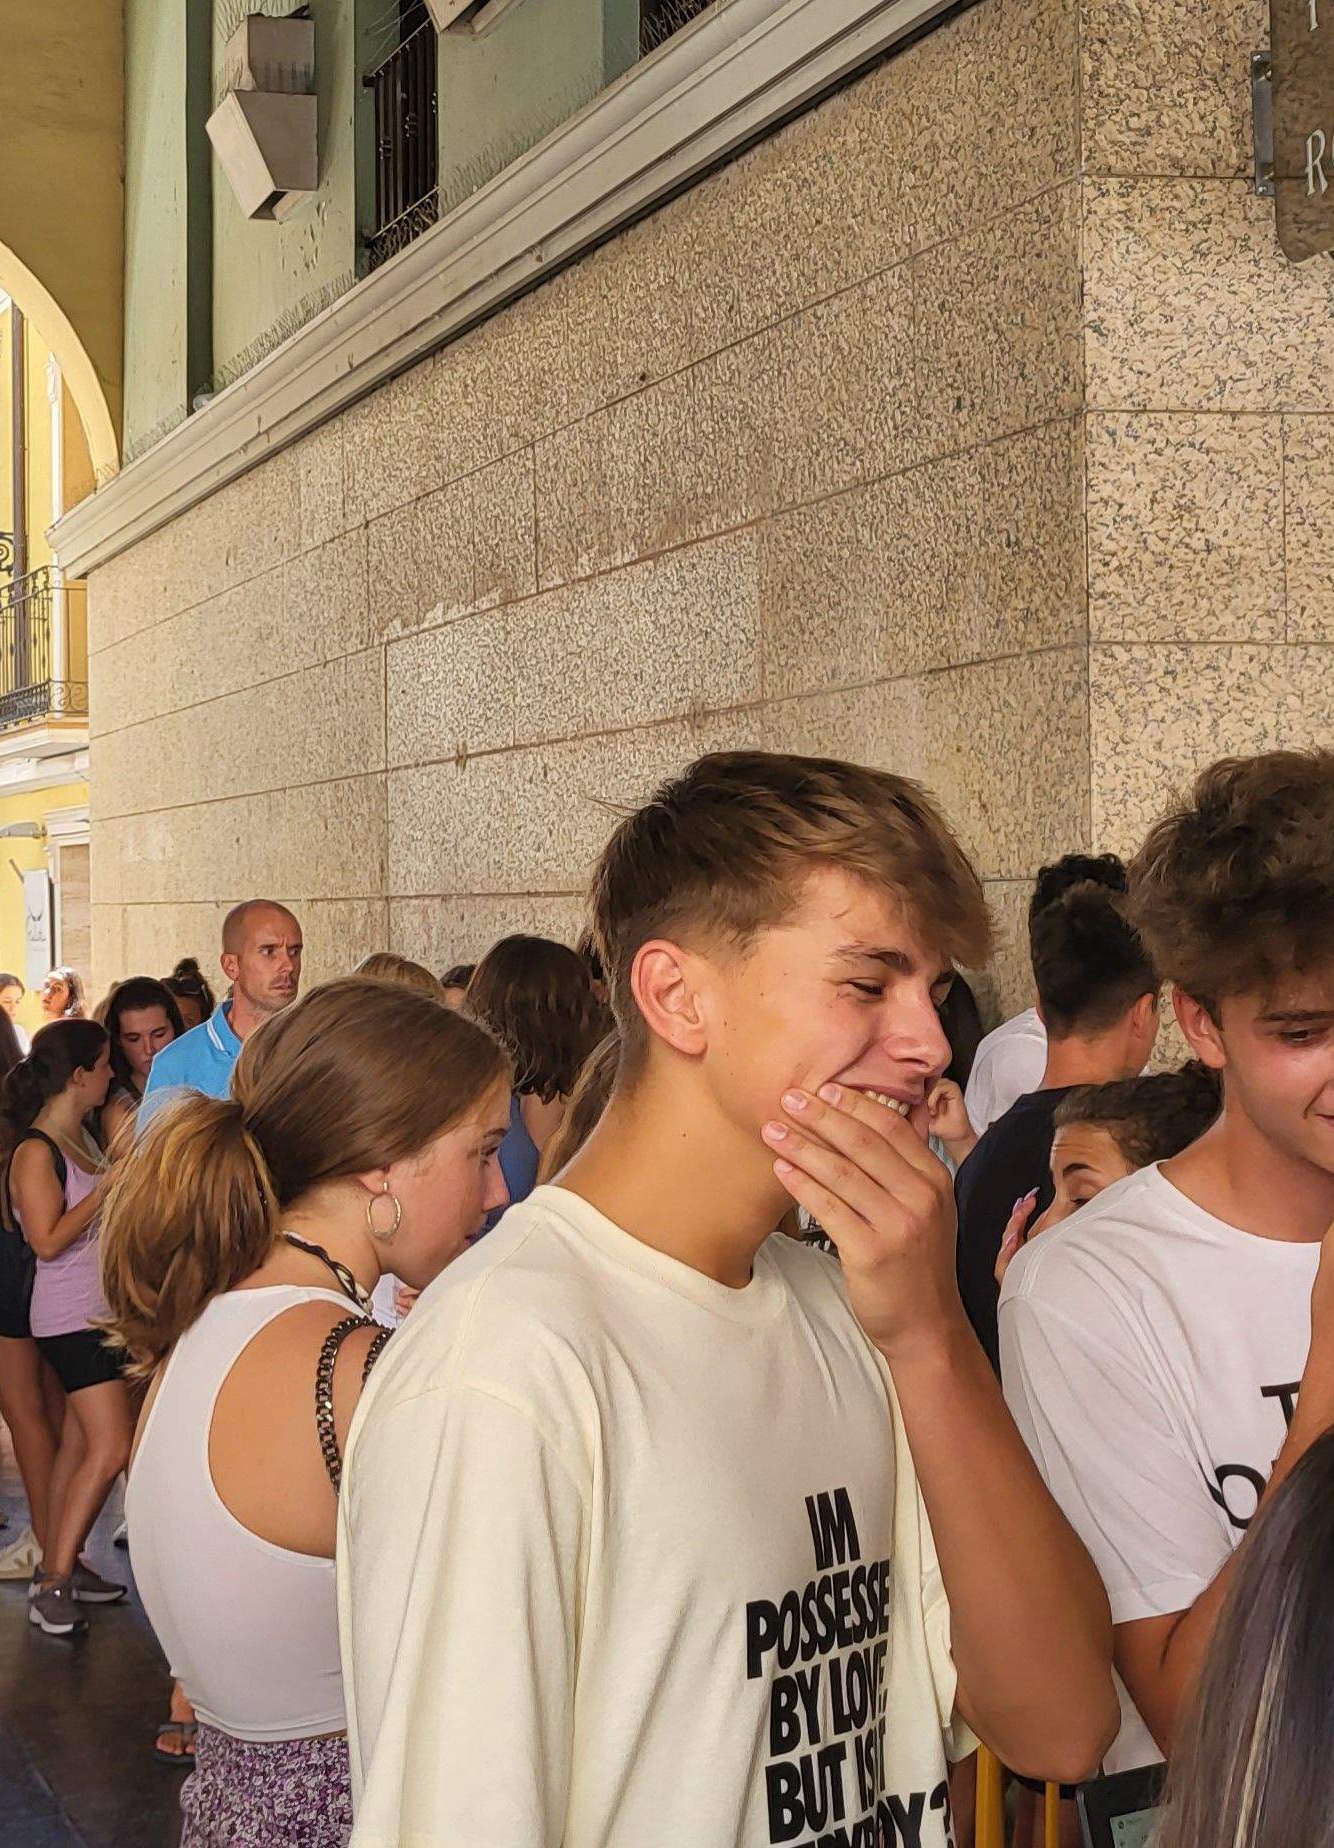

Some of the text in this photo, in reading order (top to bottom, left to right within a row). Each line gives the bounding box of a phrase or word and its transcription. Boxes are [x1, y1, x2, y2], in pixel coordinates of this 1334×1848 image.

[804, 1487, 861, 1572] IM
[770, 1664, 821, 1757] BY
[765, 1741, 847, 1845] BUT
